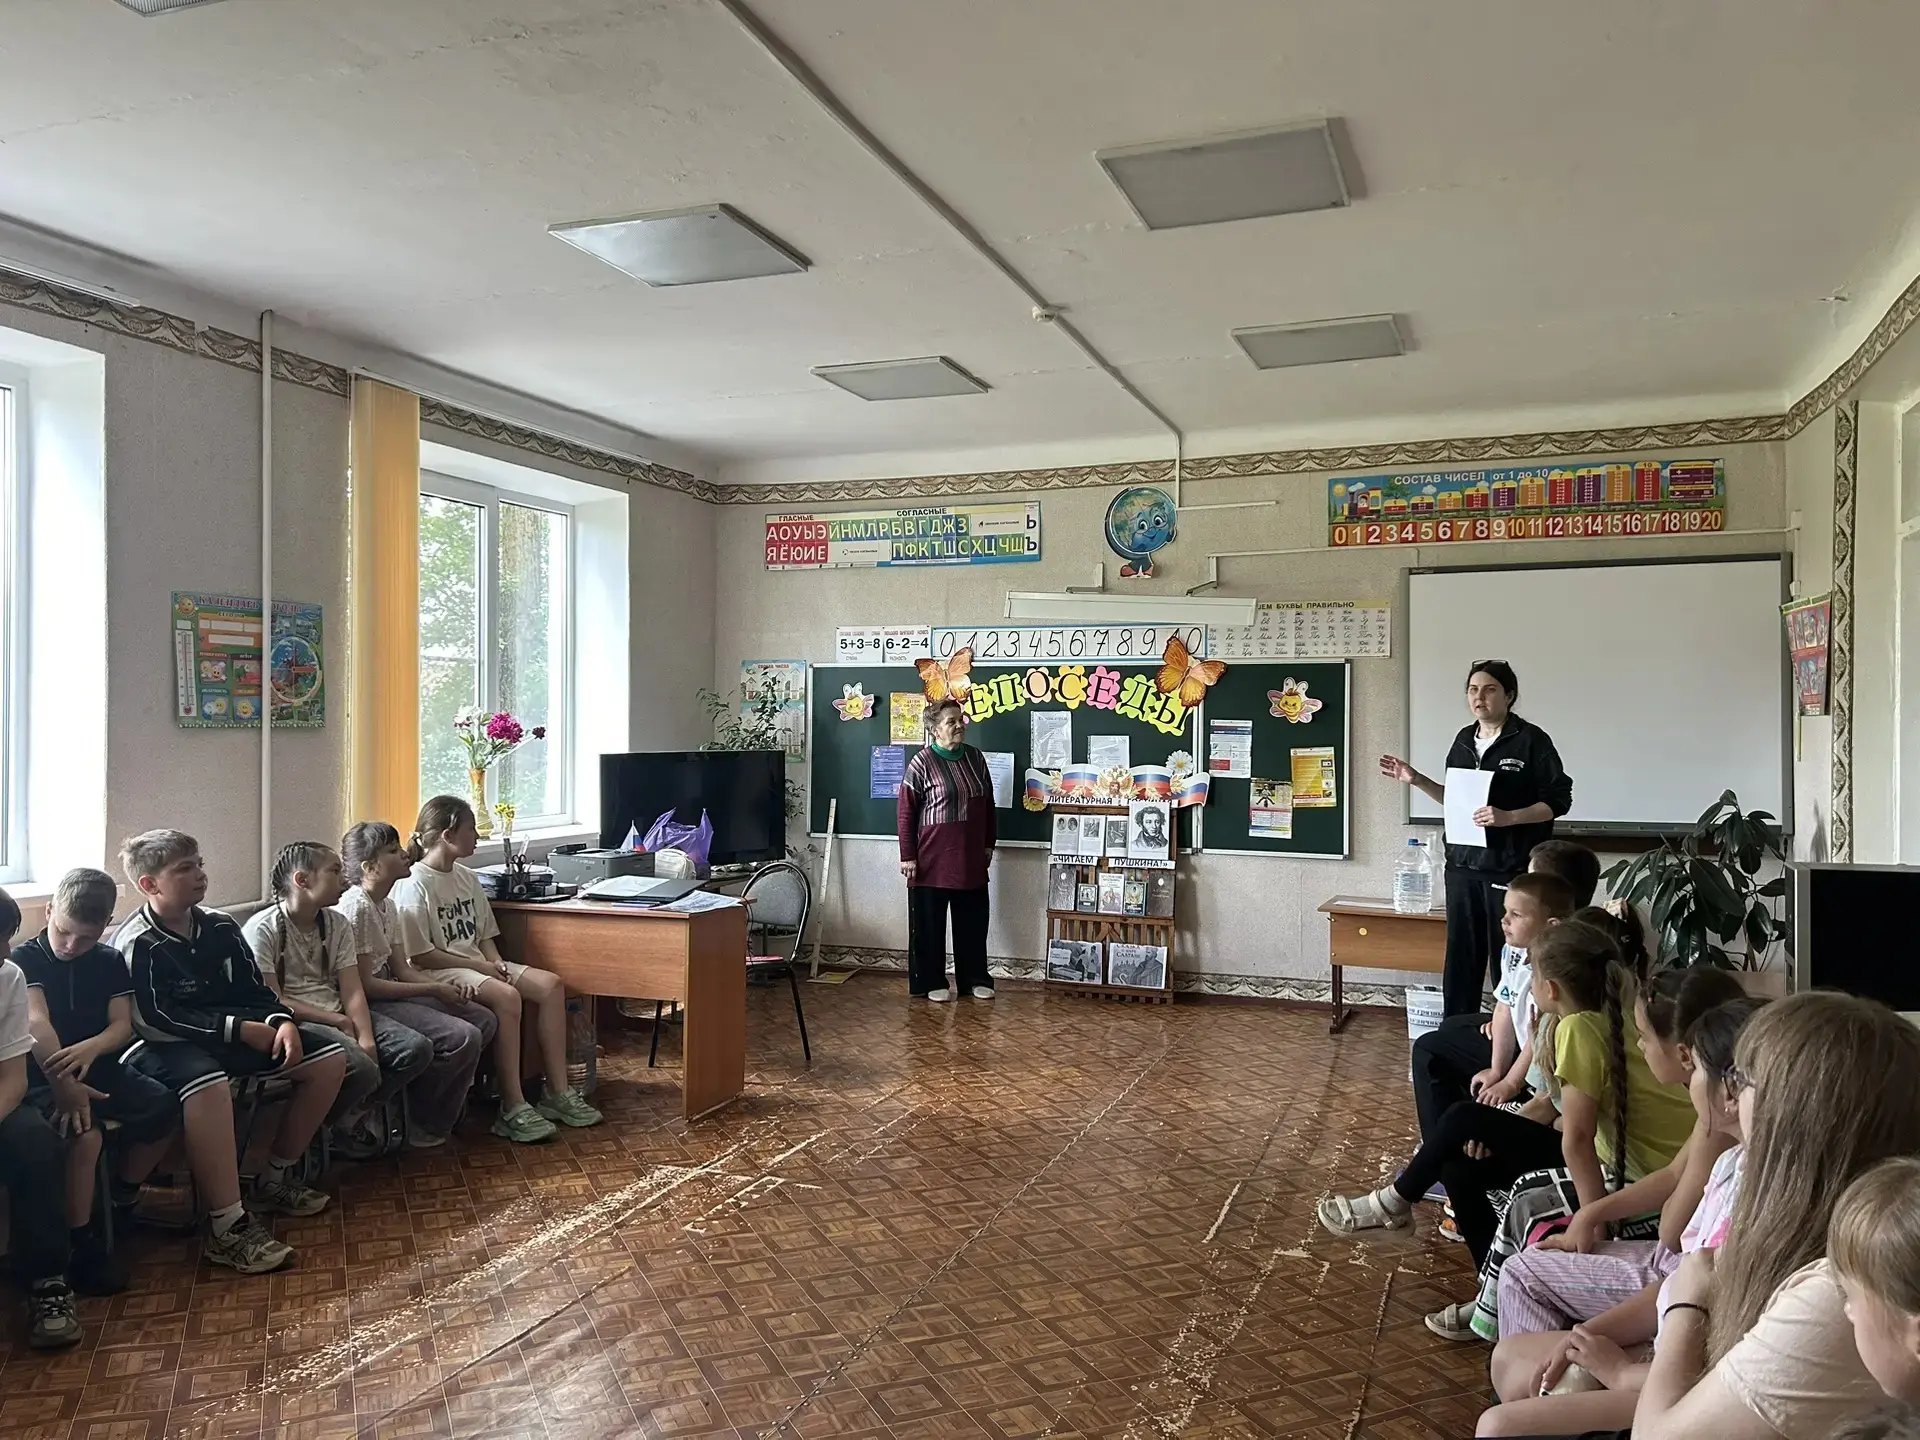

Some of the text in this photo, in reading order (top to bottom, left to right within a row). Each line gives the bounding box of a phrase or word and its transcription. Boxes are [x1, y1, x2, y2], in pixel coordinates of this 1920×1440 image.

[1394, 469, 1548, 485] СОСТАВ ЧИСЕЛ от 1 до 10
[897, 508, 947, 517] СОГЛАСНЫЕ
[1334, 511, 1722, 545] 0 1 2 3 4 5 6 7 8 9 10 11 12 13 14 15 16 17 18 19 20
[1306, 601, 1355, 609] ПРАВИЛЬНО
[840, 638, 880, 649] 5+3=8
[940, 631, 955, 657] 0
[983, 631, 999, 657] 2
[1004, 631, 1020, 657] 3
[1029, 630, 1041, 657] 4
[1046, 630, 1063, 657] 5
[1069, 630, 1086, 656] 6
[1093, 629, 1110, 656] 7
[1116, 628, 1132, 656] 8
[1140, 628, 1156, 656] 9
[970, 670, 1190, 731] ЕПОСЕДЫ
[1048, 796, 1113, 805] ЛИТЕРАТУРНАЯ
